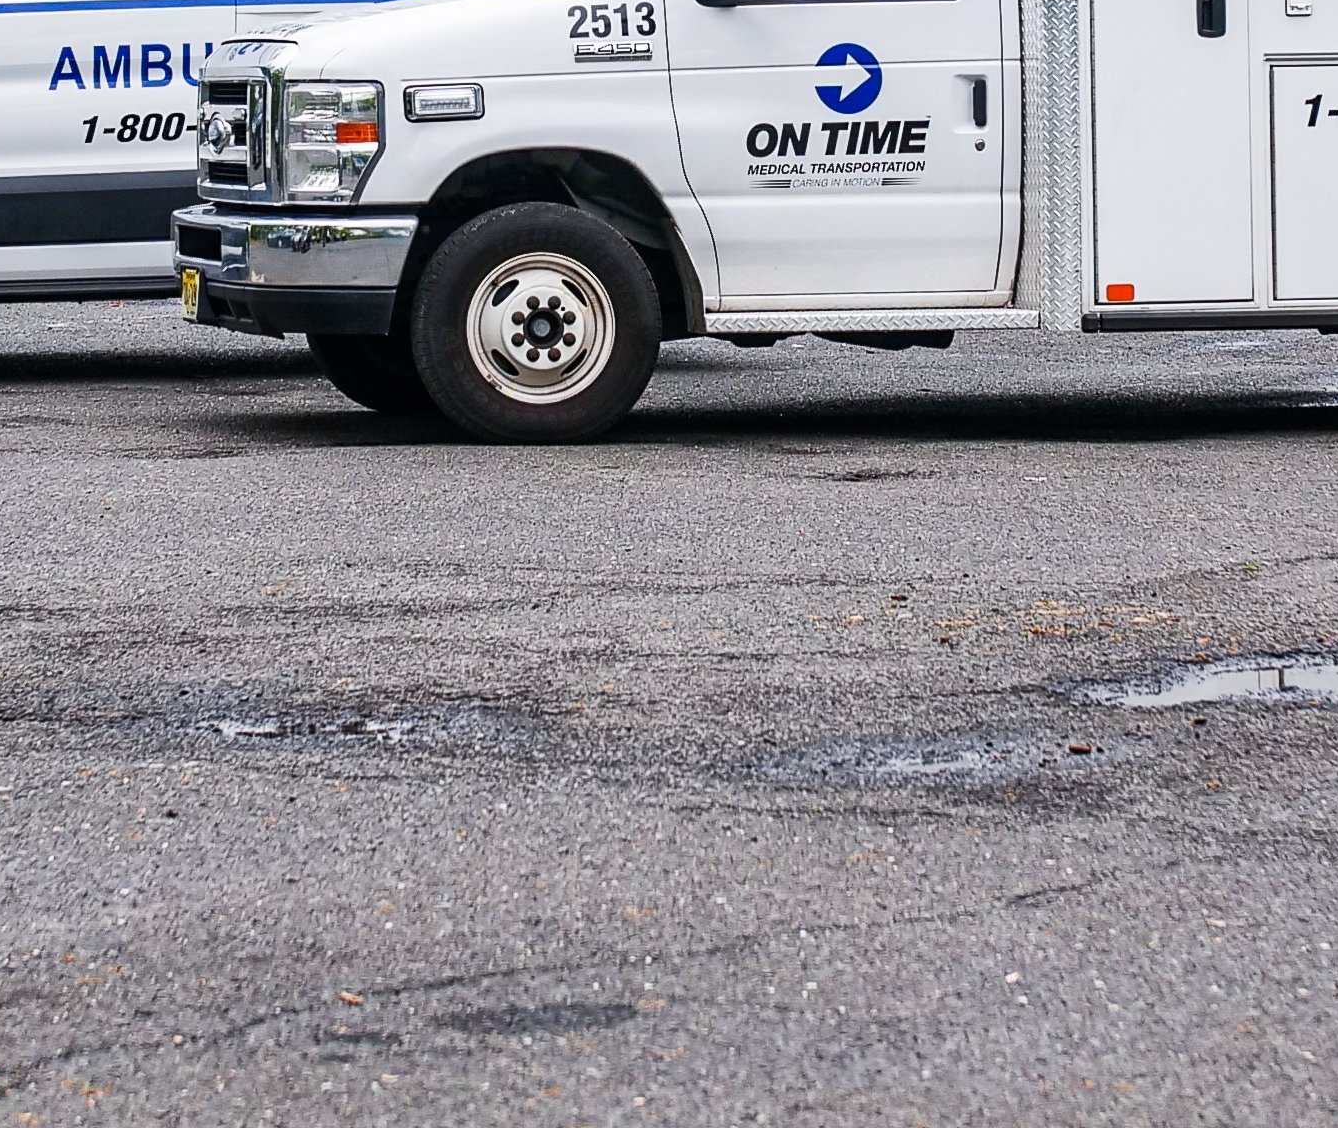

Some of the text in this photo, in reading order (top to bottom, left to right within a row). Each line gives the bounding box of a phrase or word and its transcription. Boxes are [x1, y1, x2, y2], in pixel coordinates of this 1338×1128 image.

[567, 1, 657, 39] 2513
[746, 119, 931, 158] ON TIME
[747, 160, 926, 176] MEDICAL TRANSPORTATION
[792, 177, 880, 188] CARING IN MOTION
